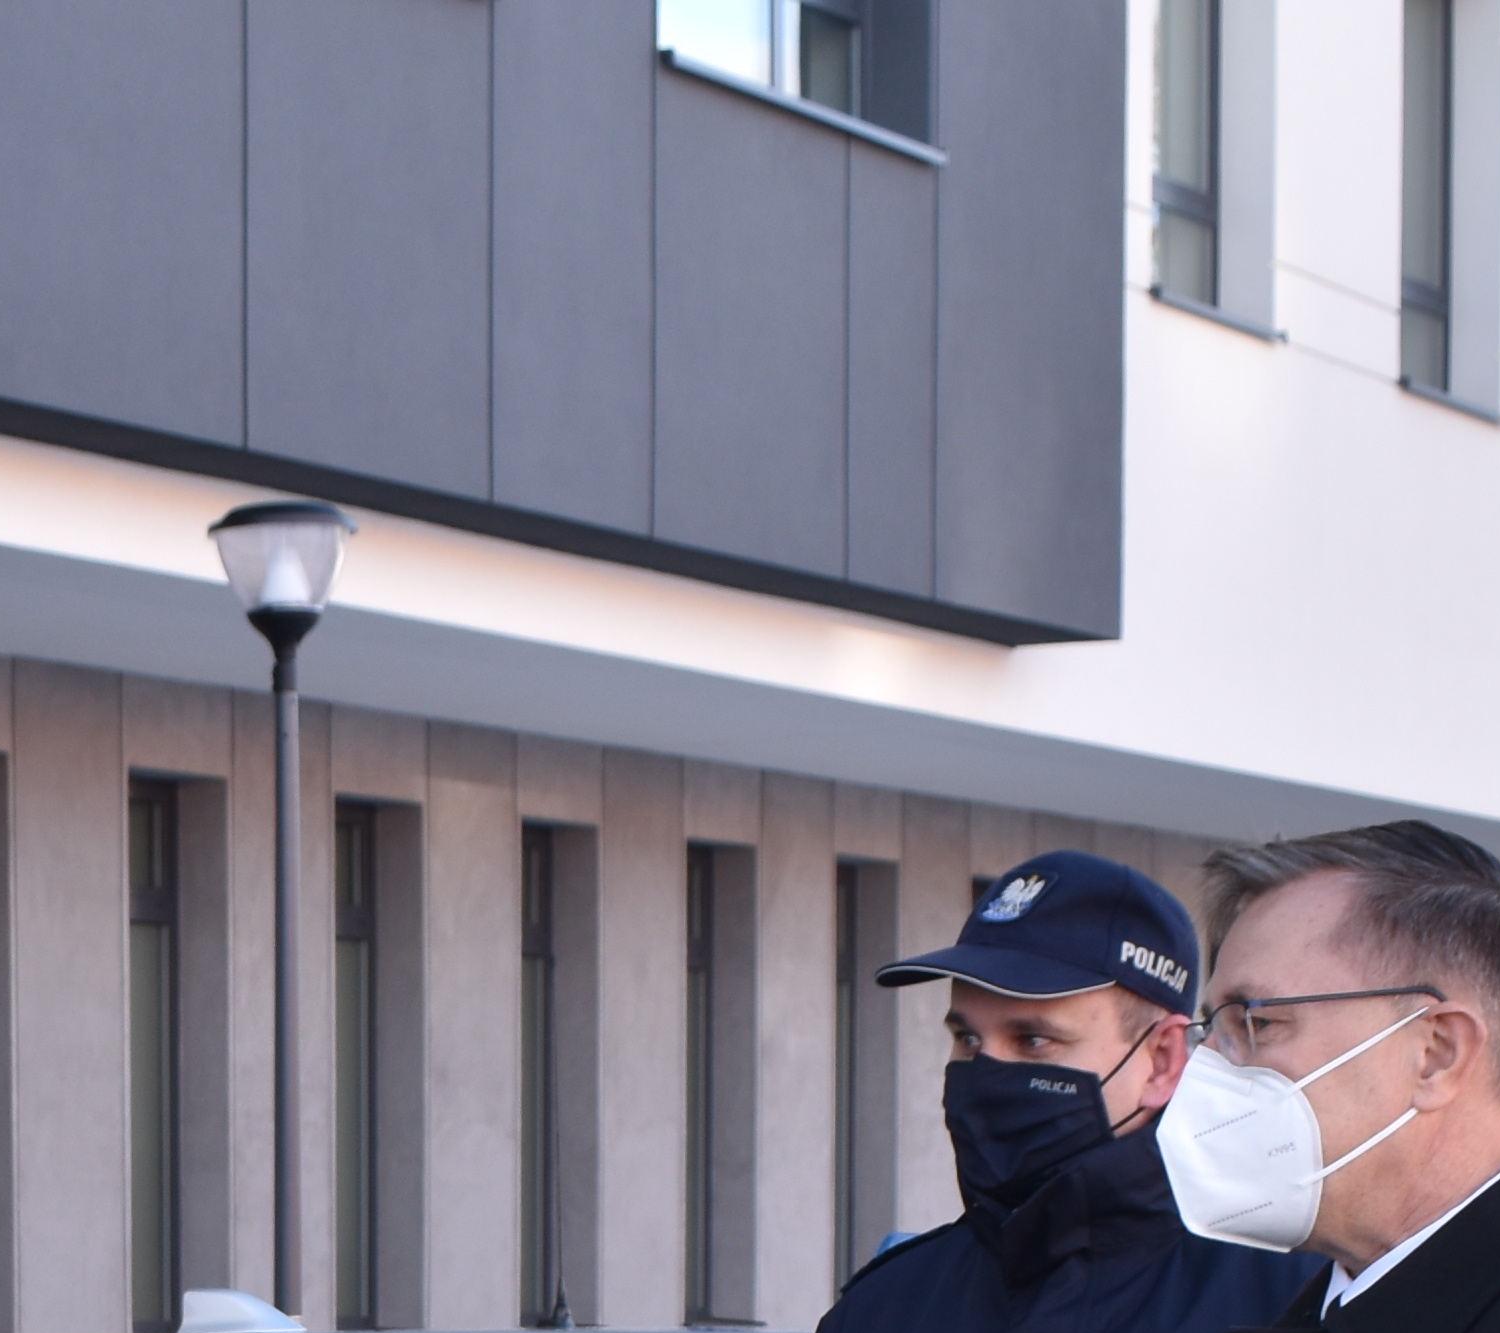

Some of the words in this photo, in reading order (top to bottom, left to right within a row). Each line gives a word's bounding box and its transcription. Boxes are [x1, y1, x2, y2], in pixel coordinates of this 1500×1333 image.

[1119, 940, 1189, 994] POLICJA
[1029, 1078, 1077, 1095] POLICJA
[1267, 1141, 1296, 1158] KN95
